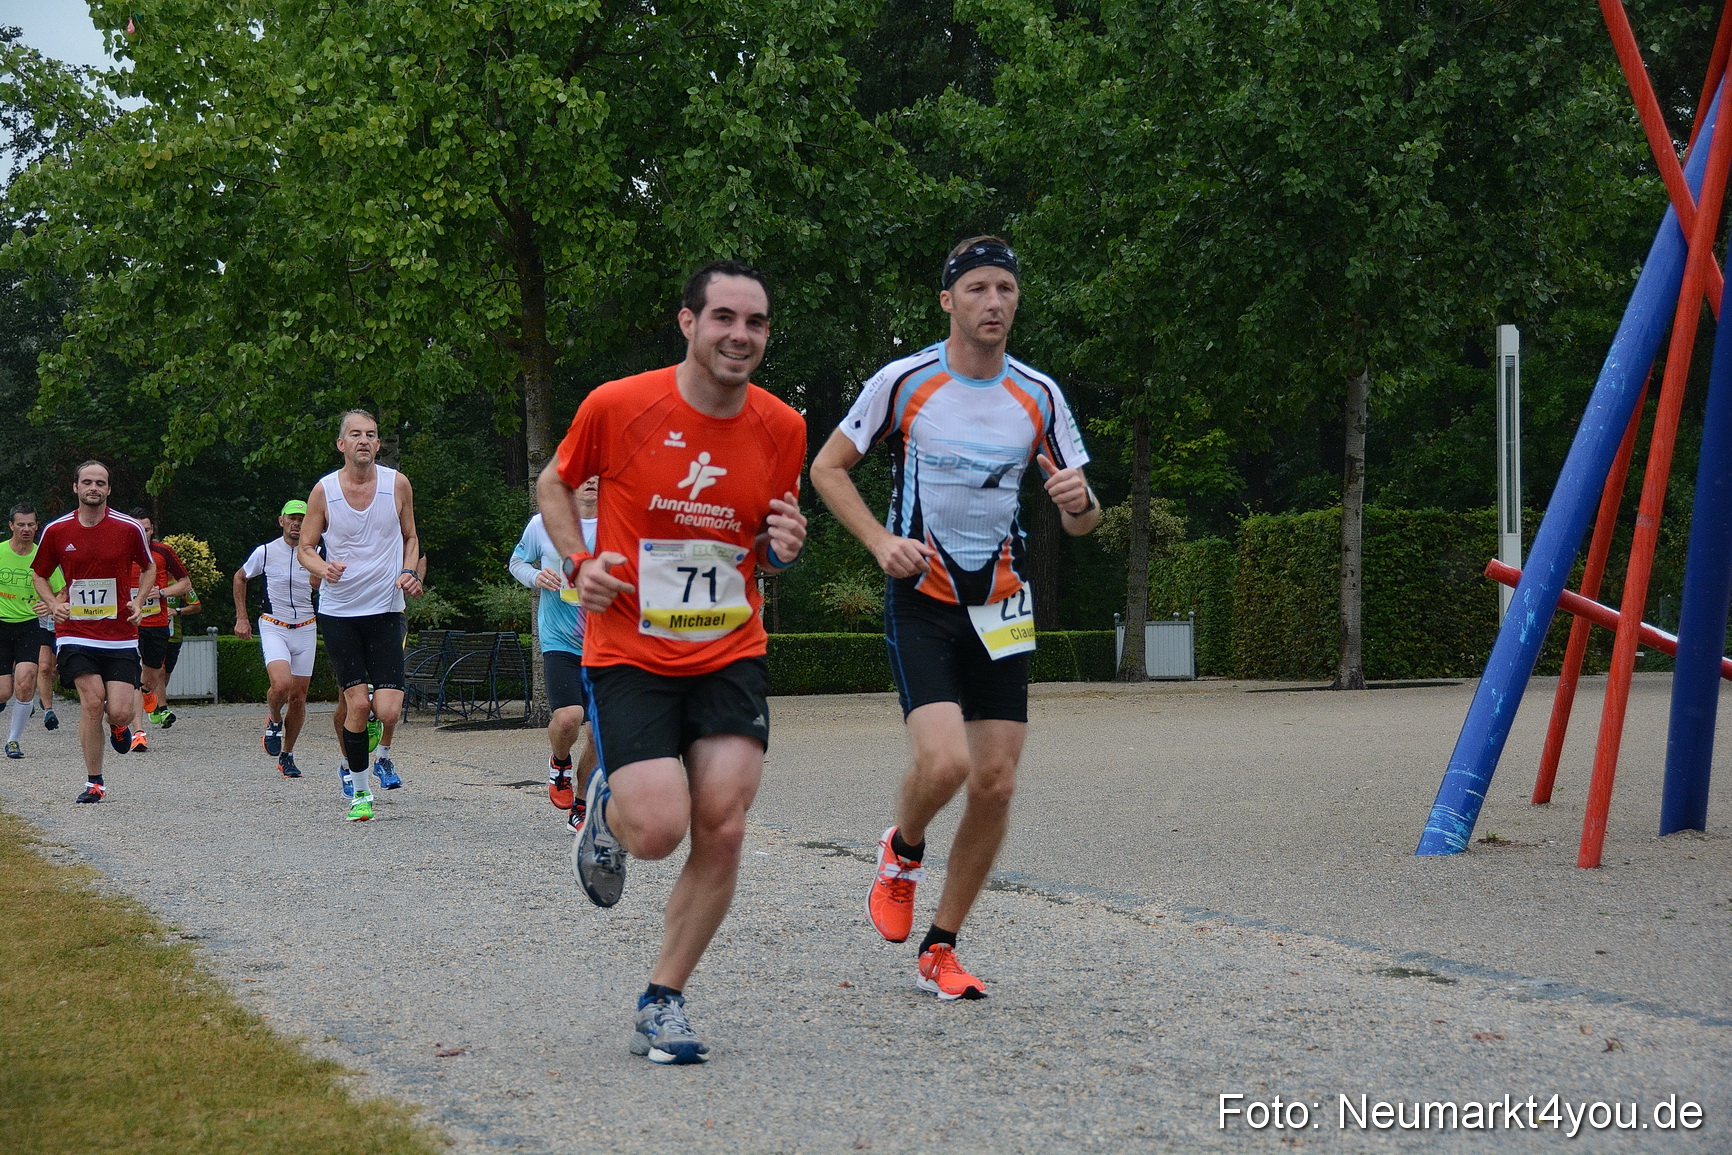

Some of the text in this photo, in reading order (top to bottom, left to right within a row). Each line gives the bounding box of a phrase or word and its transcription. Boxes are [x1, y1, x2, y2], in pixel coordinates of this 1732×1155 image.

[649, 494, 735, 518] funrunners
[674, 513, 742, 532] neumarkt
[677, 566, 717, 603] 71
[79, 589, 108, 605] 117
[83, 608, 104, 616] Martin
[669, 613, 726, 628] Michael
